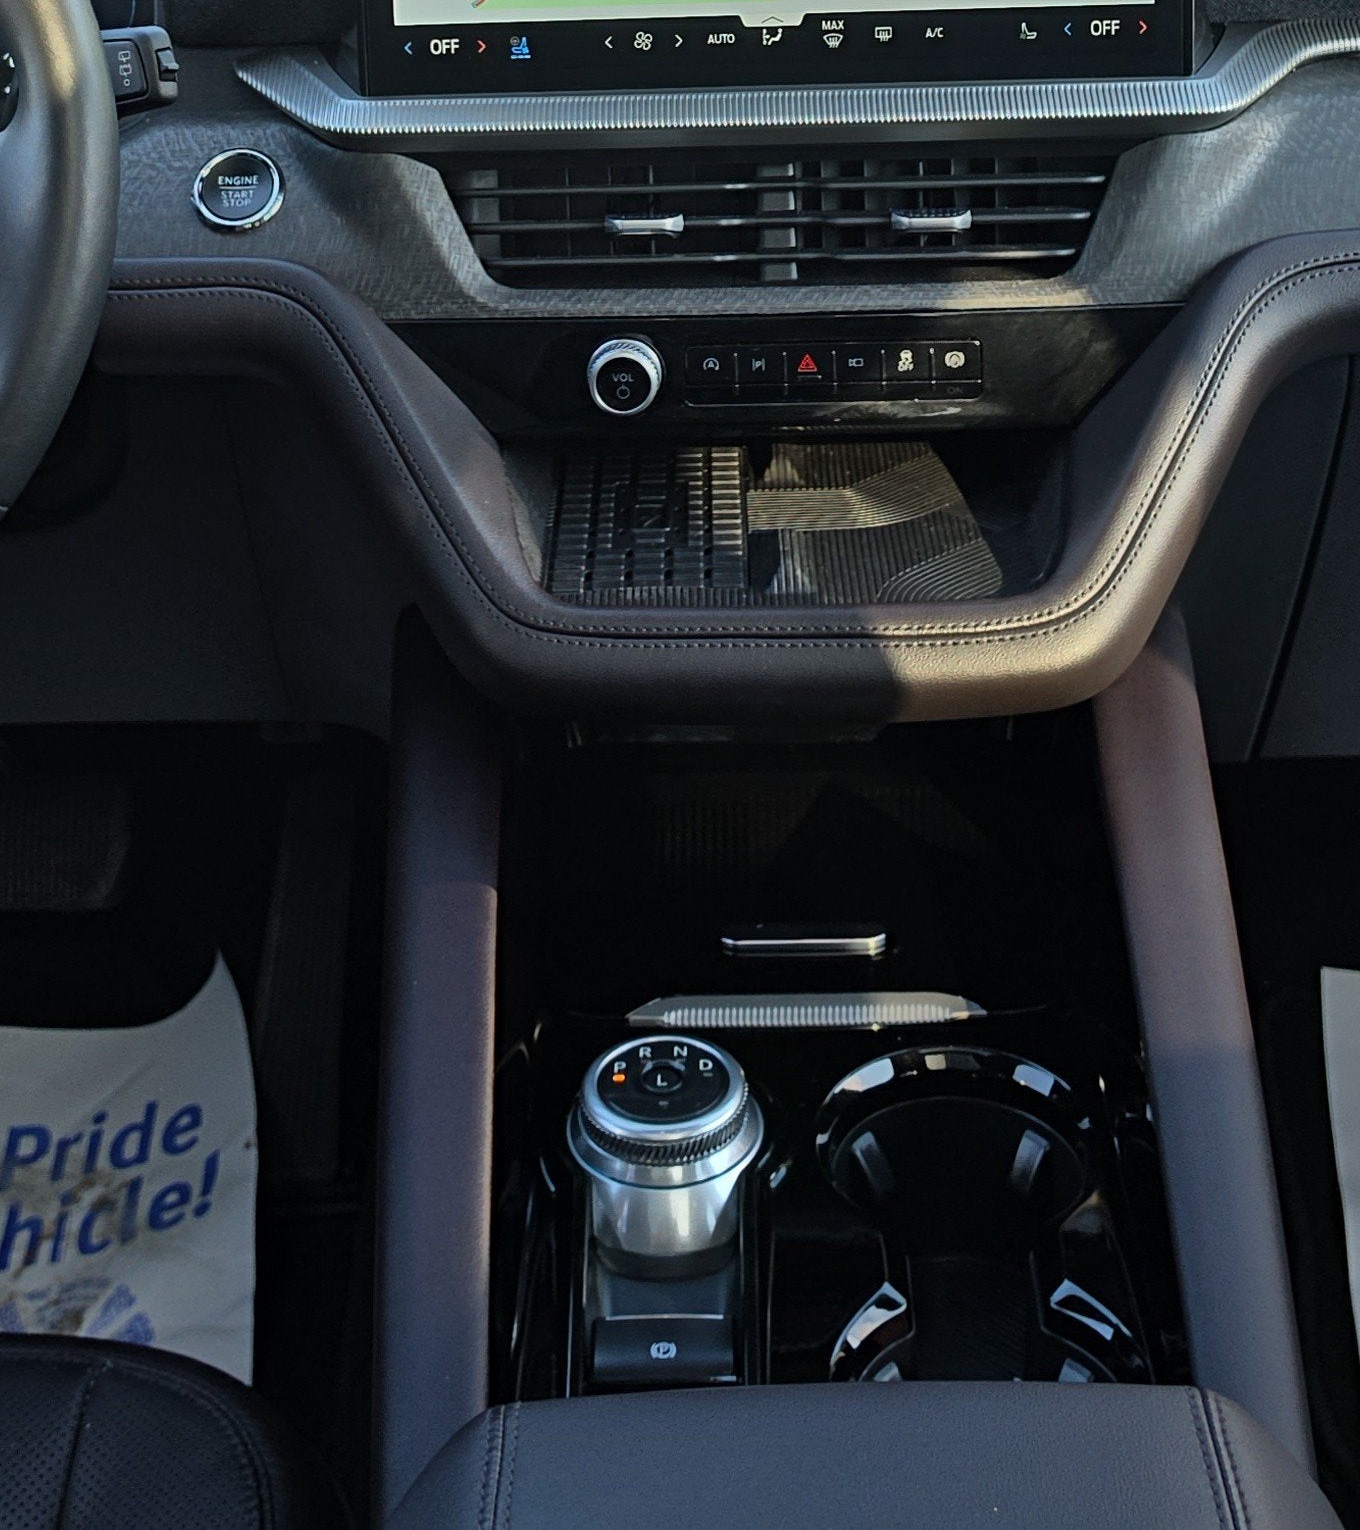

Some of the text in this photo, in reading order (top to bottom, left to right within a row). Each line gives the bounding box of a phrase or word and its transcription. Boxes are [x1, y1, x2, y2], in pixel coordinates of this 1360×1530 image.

[821, 20, 845, 31] MAX
[1090, 19, 1121, 37] OFF
[707, 33, 736, 45] AUTO
[924, 27, 944, 39] A/C
[429, 38, 460, 56] OFF
[217, 174, 260, 186] ENGINE
[220, 190, 255, 200] START
[221, 199, 252, 208] STOP
[612, 372, 635, 383] VOL
[638, 1044, 688, 1059] R N
[613, 1058, 714, 1074] P D
[656, 1073, 669, 1087] L
